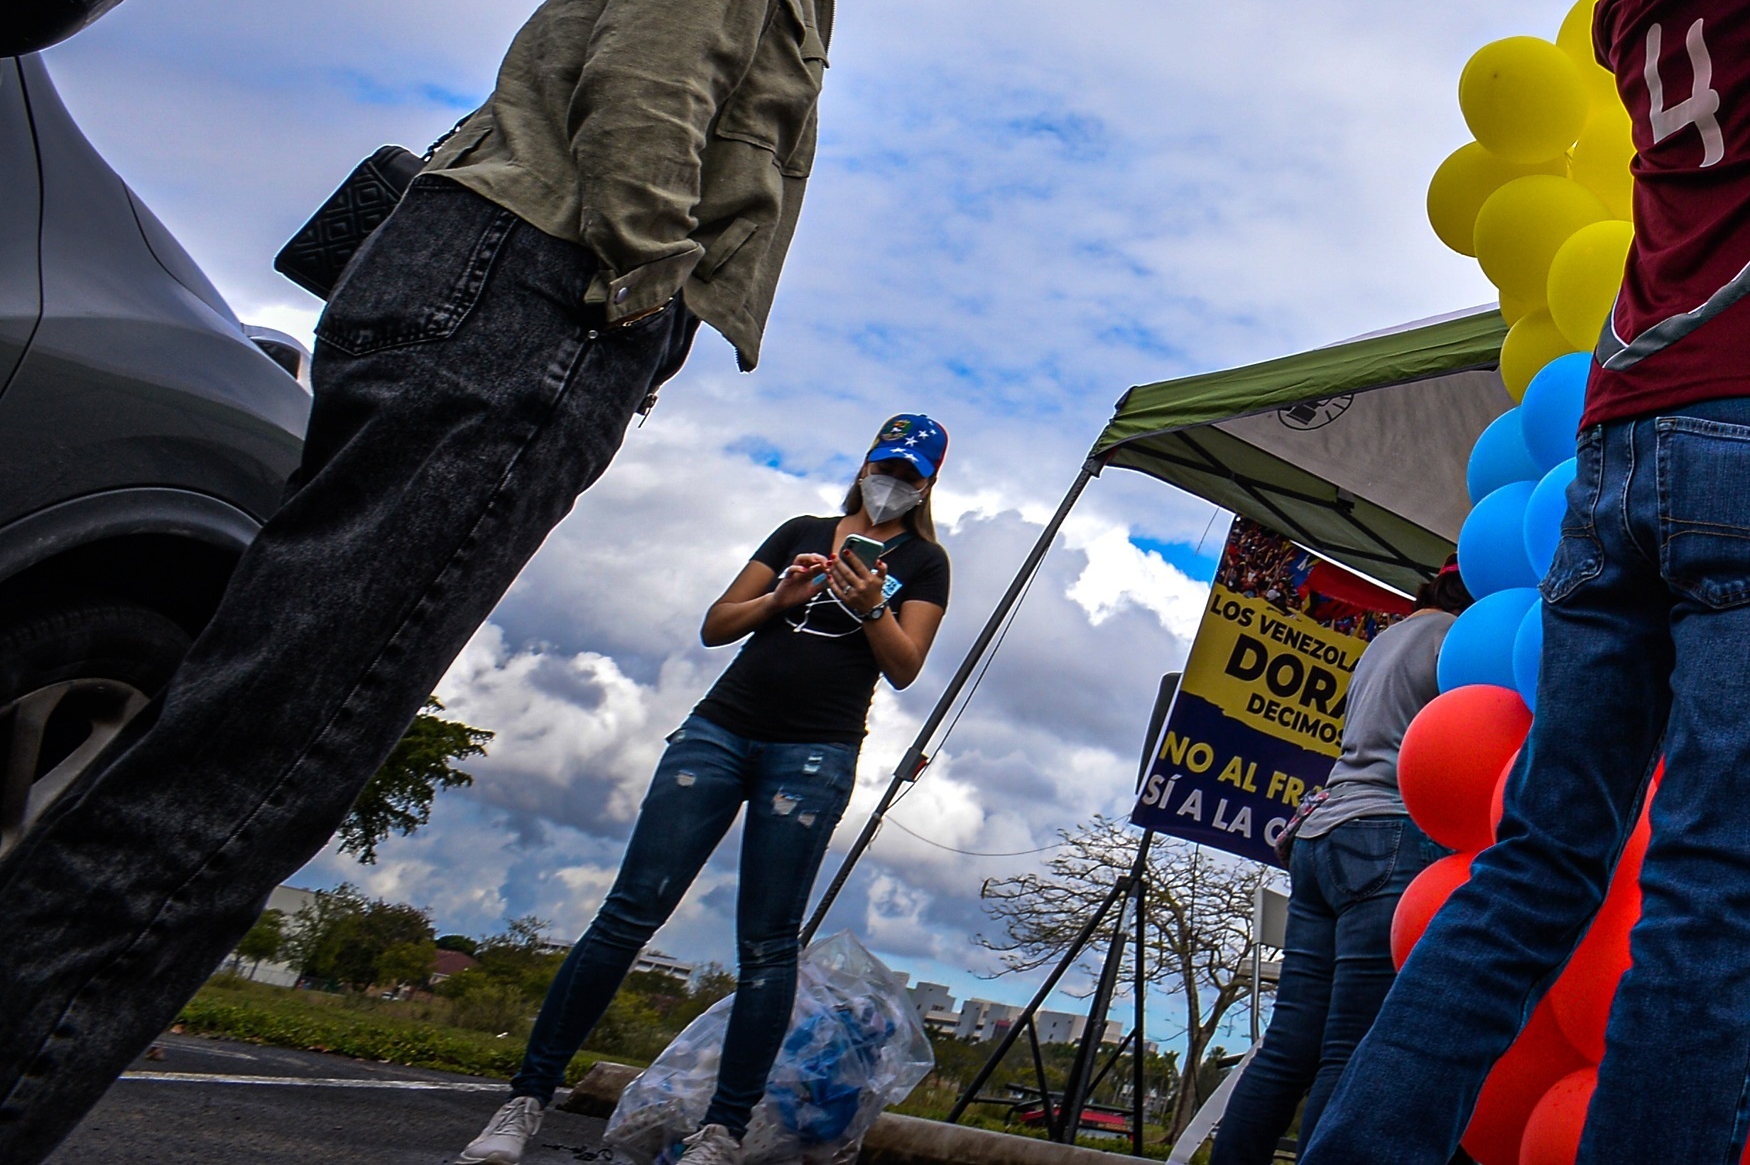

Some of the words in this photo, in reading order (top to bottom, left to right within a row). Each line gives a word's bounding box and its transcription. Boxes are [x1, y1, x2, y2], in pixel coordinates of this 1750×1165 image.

[1644, 18, 1725, 168] 4
[1210, 594, 1255, 627] LOS
[1159, 731, 1214, 773] NO
[1217, 755, 1258, 793] AL
[1266, 770, 1322, 808] FR
[1142, 773, 1183, 810] SÍ
[1177, 788, 1202, 821] A
[1212, 798, 1252, 839] LA
